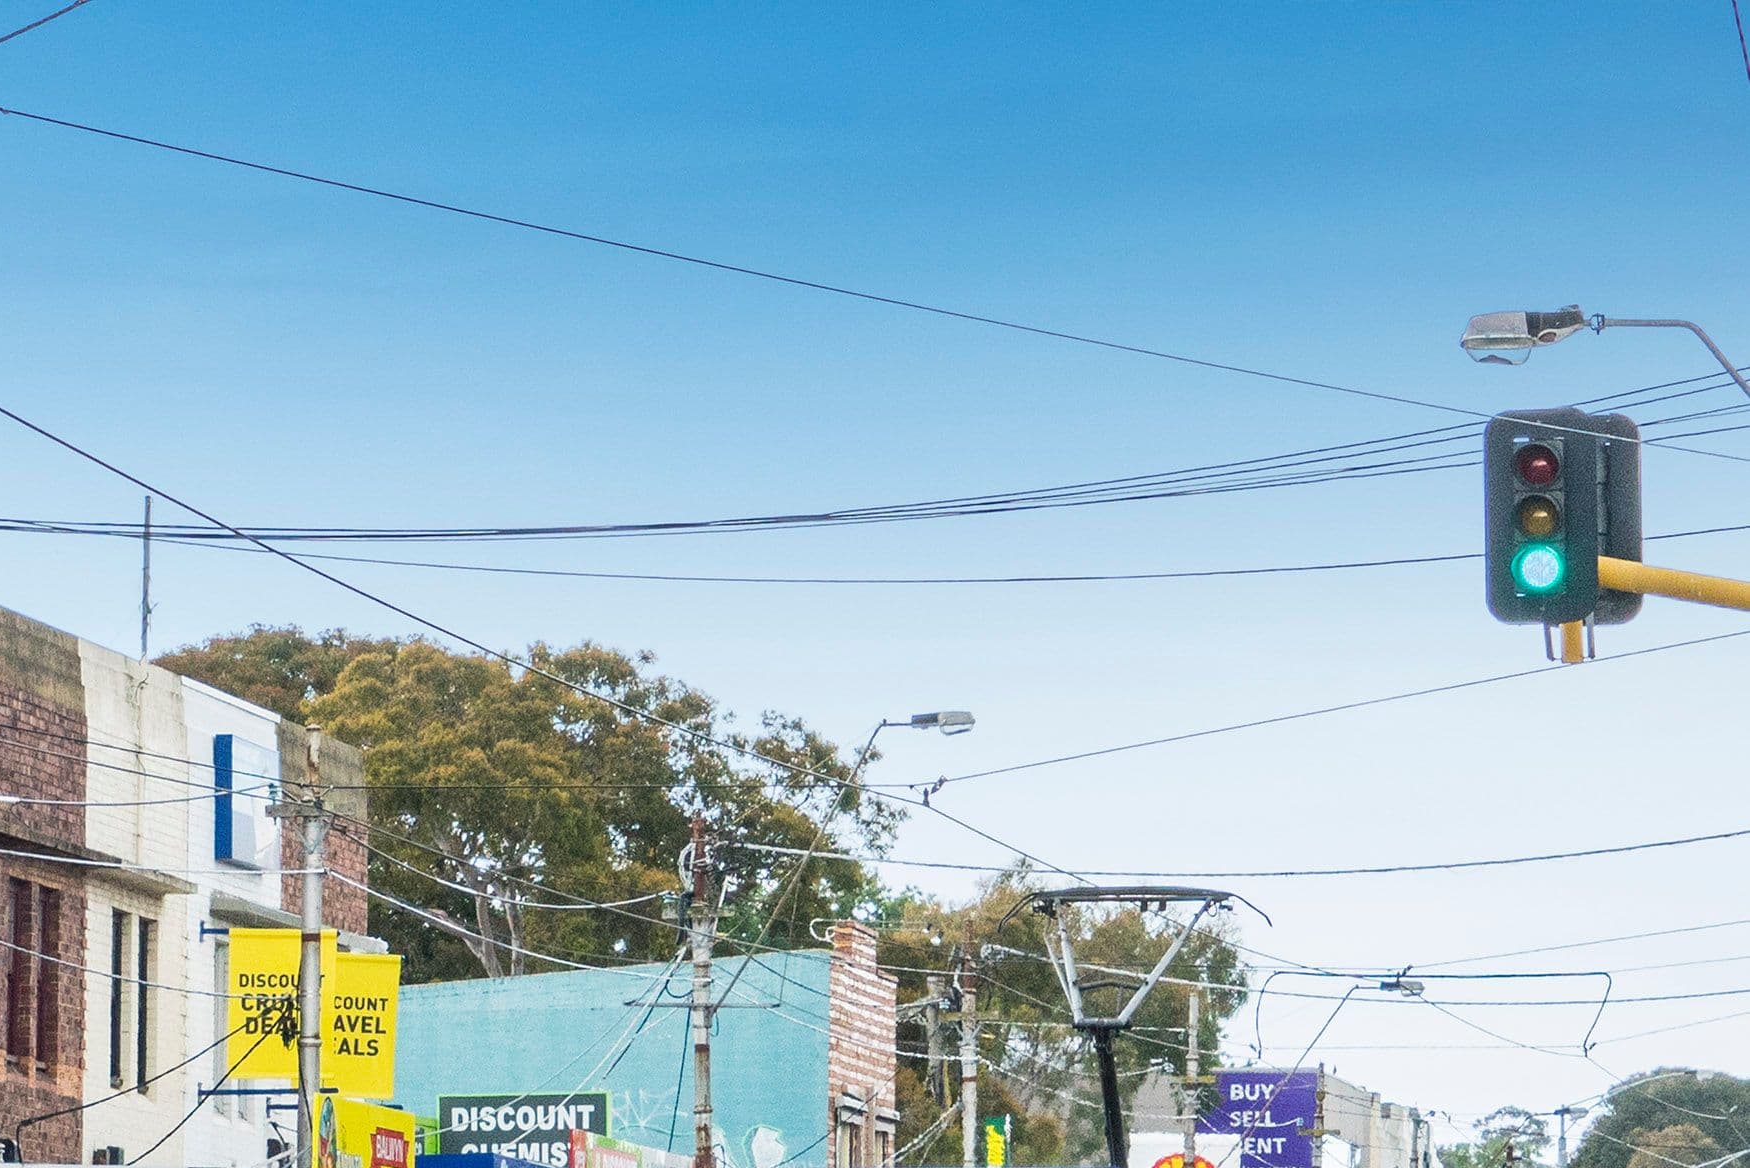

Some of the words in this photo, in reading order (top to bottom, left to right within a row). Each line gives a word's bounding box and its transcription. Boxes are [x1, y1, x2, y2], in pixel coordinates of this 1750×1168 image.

[334, 996, 389, 1011] COUNT
[334, 1015, 387, 1034] AVEL
[334, 1037, 380, 1056] ALS
[1230, 1083, 1274, 1101] BUY
[451, 1104, 595, 1132] DISCOUNT
[1230, 1110, 1277, 1128] SELL
[1243, 1137, 1287, 1155] ENT
